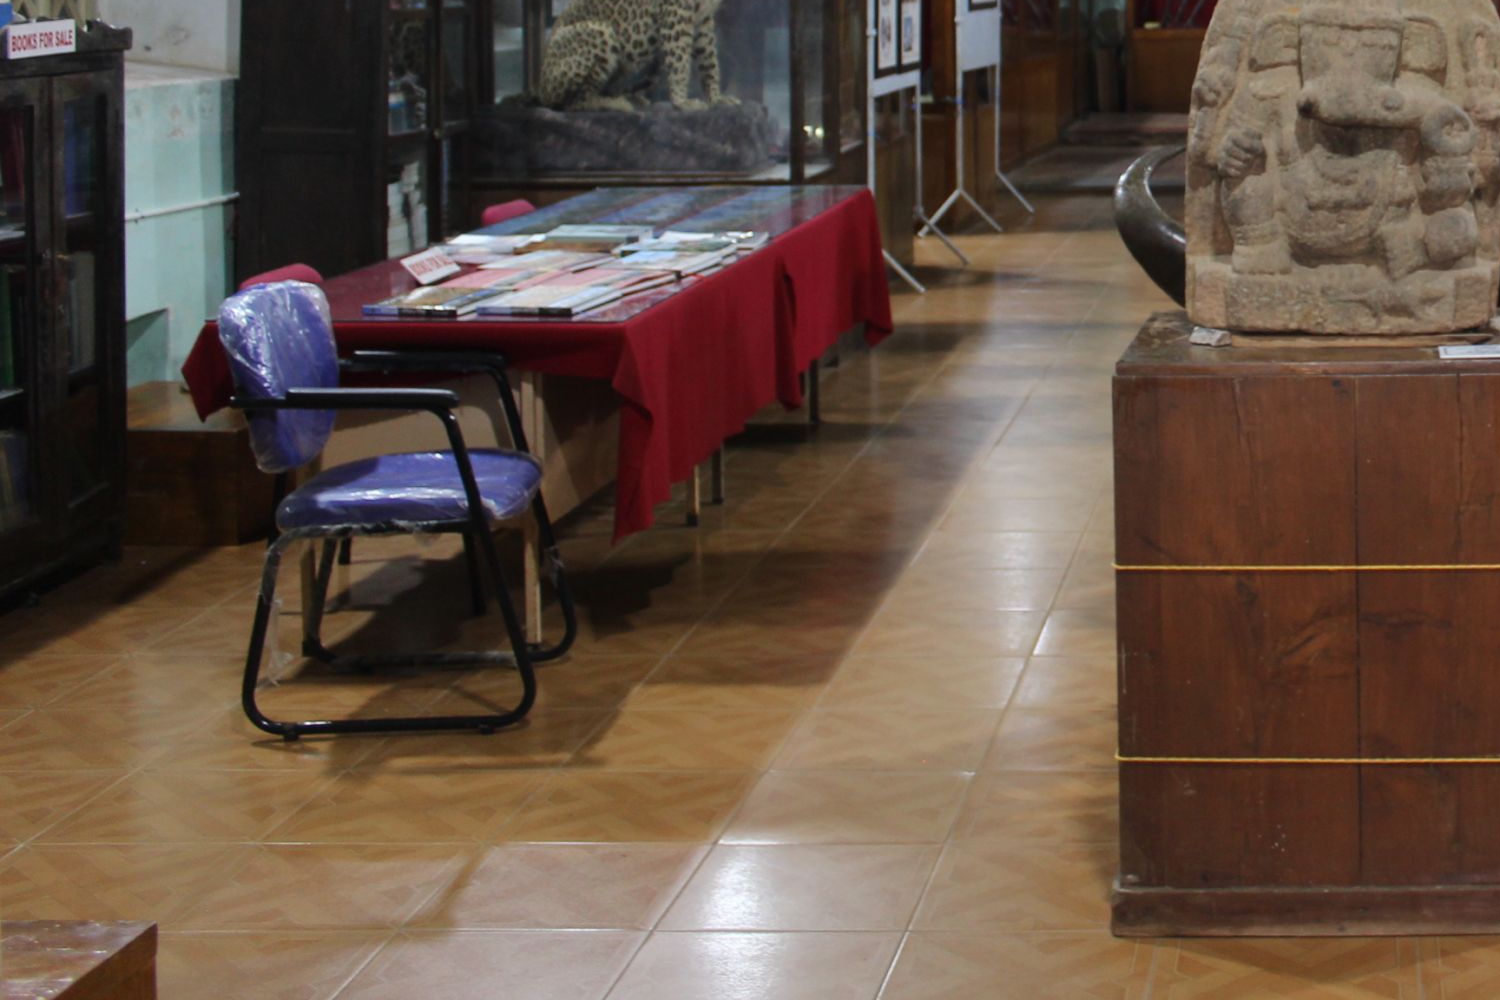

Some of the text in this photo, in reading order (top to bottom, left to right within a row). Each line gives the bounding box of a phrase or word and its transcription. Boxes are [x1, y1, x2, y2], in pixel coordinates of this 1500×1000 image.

[12, 29, 73, 52] BOOKS FOR SALE
